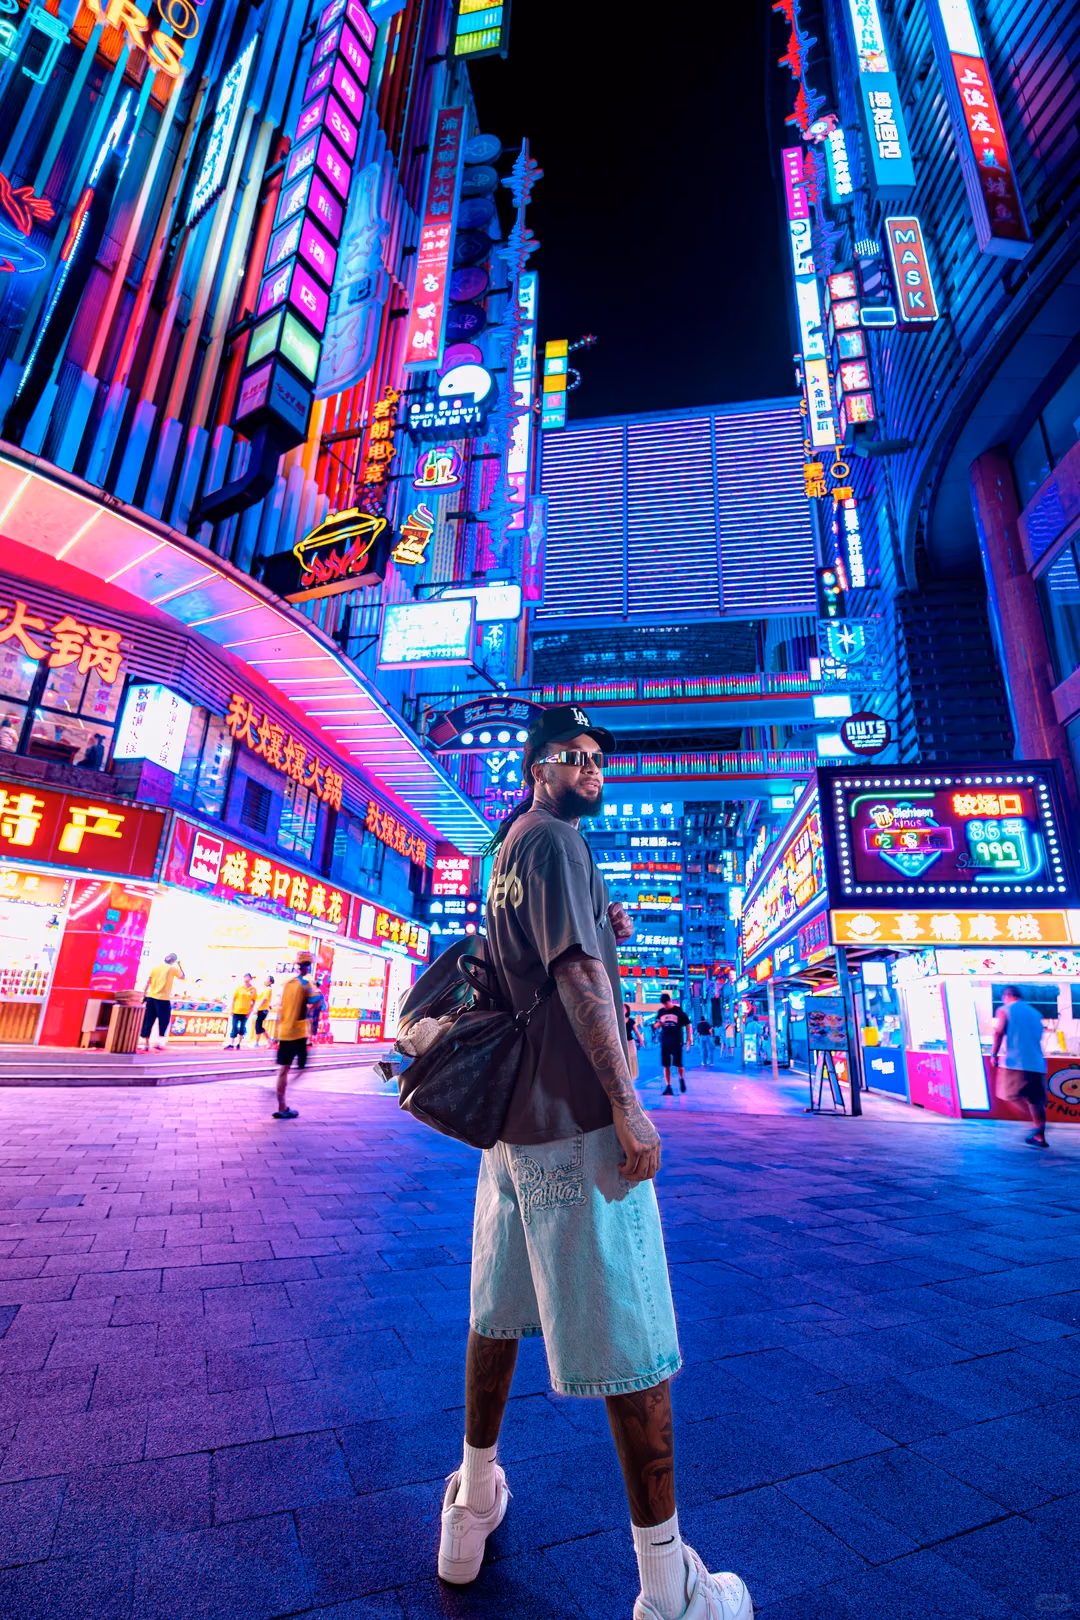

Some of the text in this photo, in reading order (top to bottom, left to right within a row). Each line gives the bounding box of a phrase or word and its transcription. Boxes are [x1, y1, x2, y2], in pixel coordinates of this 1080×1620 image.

[894, 229, 926, 309] MASK
[410, 412, 481, 429] YUMMY!
[0, 600, 125, 684] 火锅
[570, 707, 591, 728] LA
[845, 720, 886, 735] NUTS
[0, 789, 126, 854] 特产
[976, 841, 1017, 861] 999
